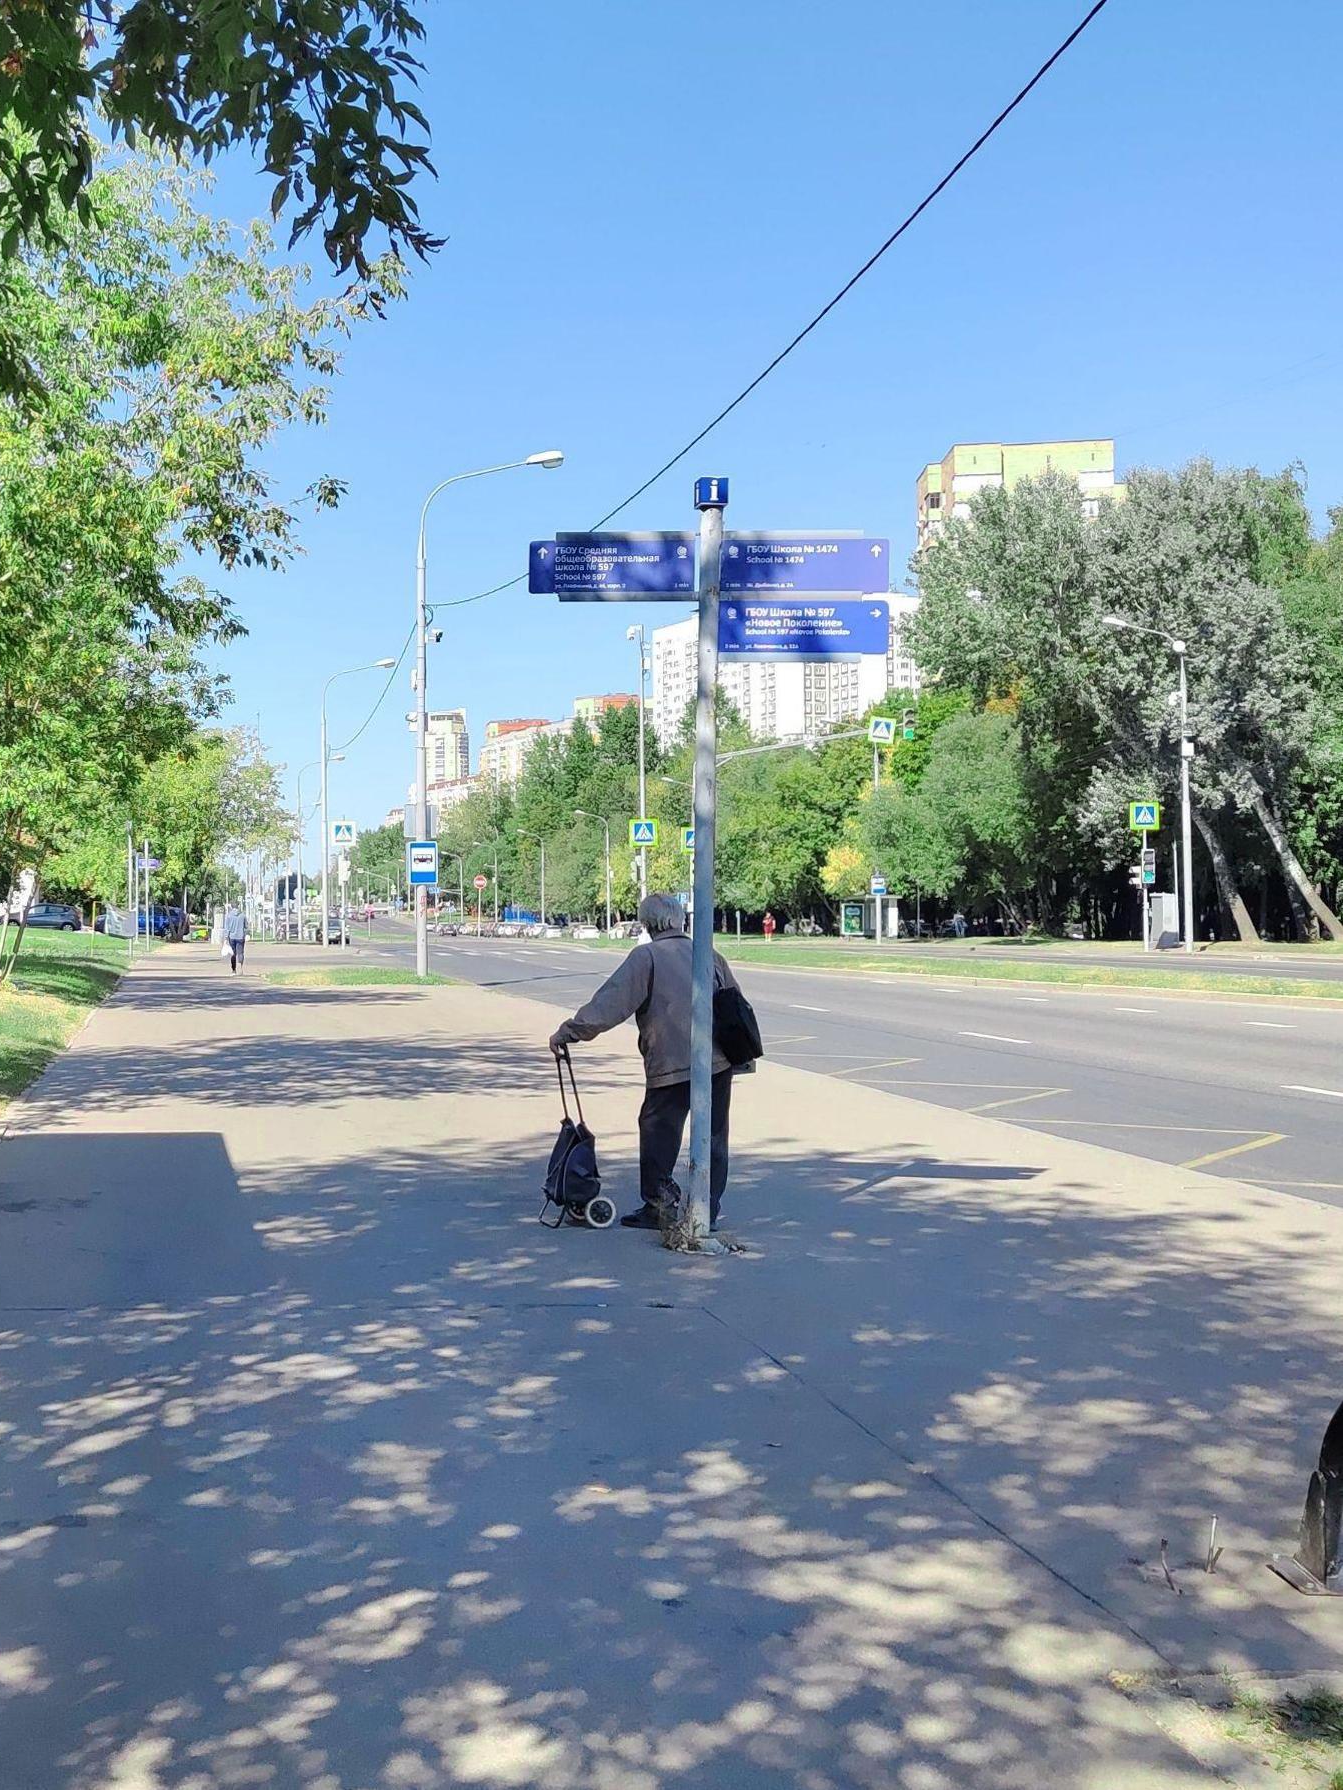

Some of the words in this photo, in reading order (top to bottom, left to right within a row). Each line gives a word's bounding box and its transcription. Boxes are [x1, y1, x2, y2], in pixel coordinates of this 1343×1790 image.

[555, 547, 577, 555] ГБОУ
[578, 547, 618, 557] Средняя
[746, 545, 770, 553] ГБОУ
[771, 545, 802, 553] Школа
[804, 545, 814, 553] №
[816, 545, 838, 553] 1474
[555, 555, 660, 565] общеобразовательная
[555, 564, 584, 572] школа
[586, 563, 597, 572] №
[598, 563, 614, 571] 597
[554, 573, 581, 581] School
[745, 608, 769, 617] ГБОУ
[770, 608, 802, 617] Школа
[804, 608, 816, 617] №
[818, 608, 835, 617] 597
[745, 618, 781, 627] «Новое
[783, 618, 843, 627] Поколение»
